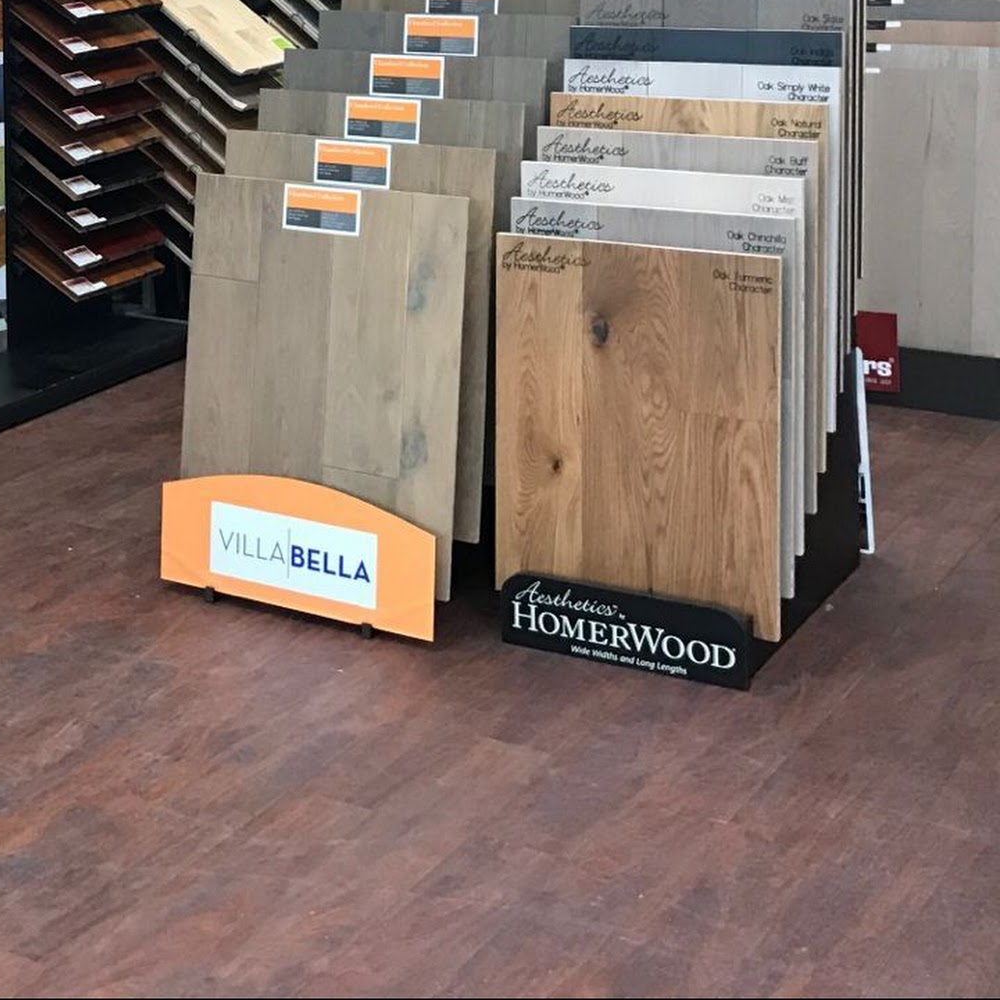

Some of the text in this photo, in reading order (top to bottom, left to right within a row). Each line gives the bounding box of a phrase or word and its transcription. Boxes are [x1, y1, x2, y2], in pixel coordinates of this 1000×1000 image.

[568, 65, 655, 86] Aesthetics
[757, 81, 831, 93] Oak Simply White
[788, 92, 829, 102] Character
[556, 99, 643, 122] Aesthetics
[770, 117, 822, 129] Oak Natural
[778, 128, 821, 139] Character
[543, 134, 629, 156] Aesthetics
[769, 156, 785, 165] Oak
[765, 165, 808, 176] Character
[527, 169, 615, 193] Aesthetics
[515, 207, 606, 230] Aesthetics
[727, 230, 743, 240] Oak
[501, 241, 591, 267] Aesthetics
[742, 242, 785, 254] Character
[712, 269, 729, 280] Oak
[729, 282, 773, 295] Character
[219, 528, 371, 584] VILLA BELLA
[515, 580, 617, 617] Aesthetics
[570, 645, 688, 675] Wide Widths and Long Lengths
